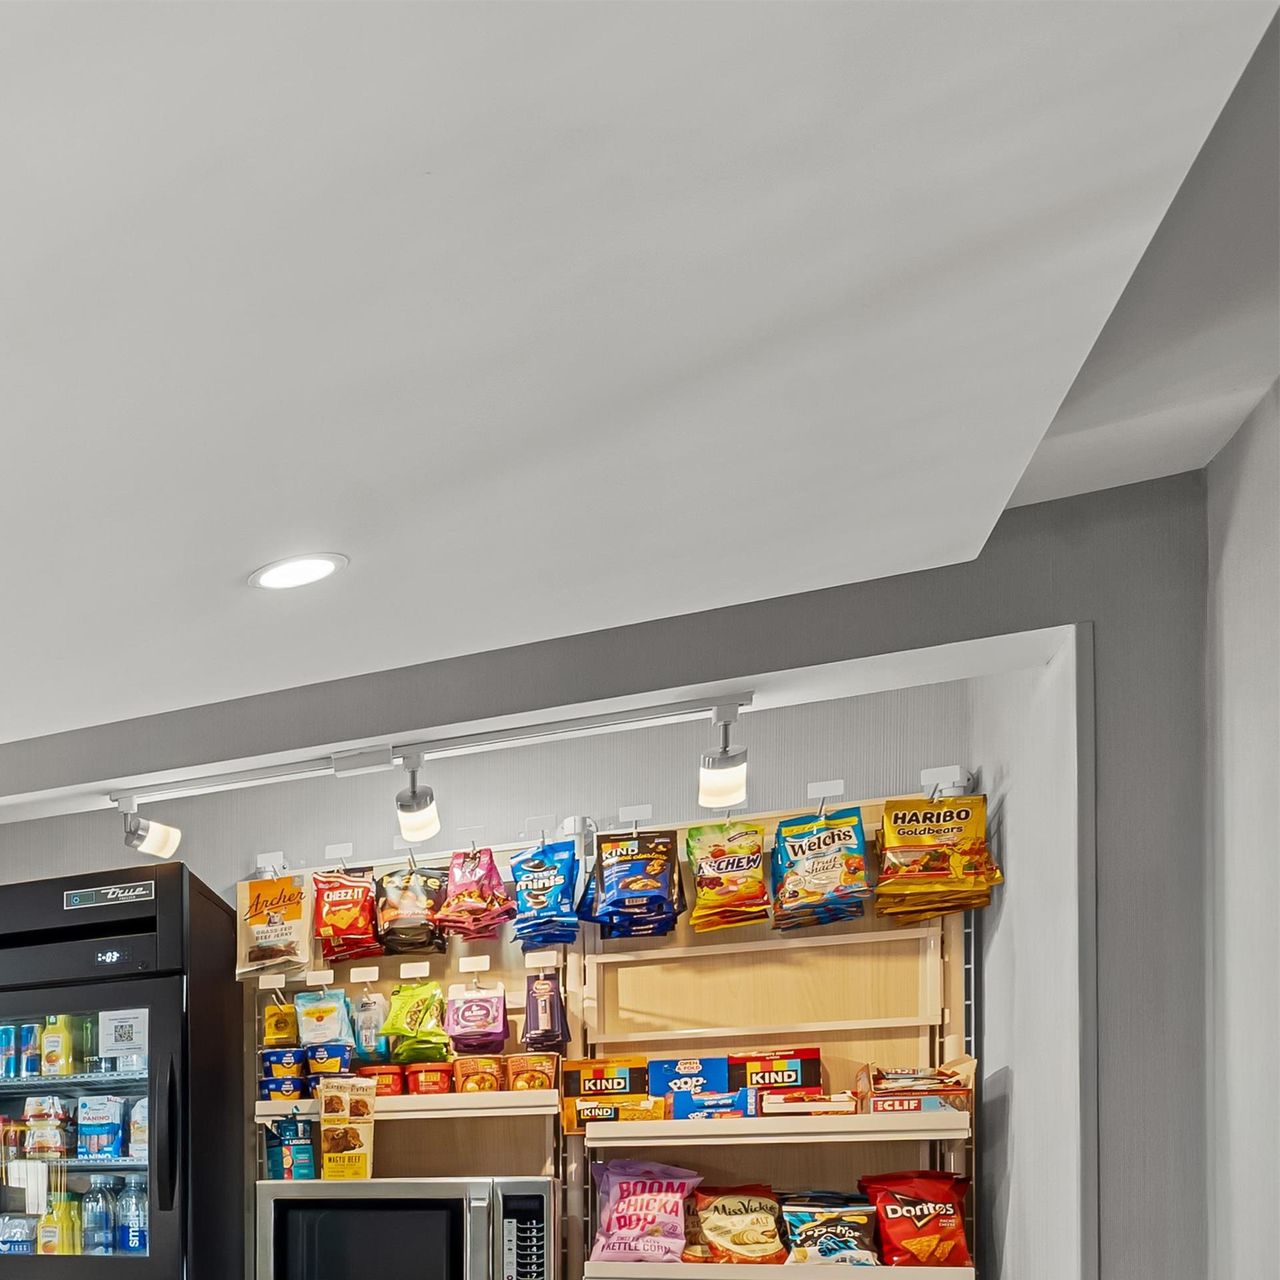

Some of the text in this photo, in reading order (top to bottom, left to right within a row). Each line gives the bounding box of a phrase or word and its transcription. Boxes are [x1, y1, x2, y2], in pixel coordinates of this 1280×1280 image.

[893, 808, 972, 825] HARIBO
[896, 825, 964, 836] Goldbears
[789, 829, 853, 857] Welch's
[602, 847, 639, 861] KIND
[516, 875, 565, 891] minis
[323, 888, 364, 901] CHEEZ-IT
[244, 888, 306, 917] Archer
[273, 931, 293, 939] JERKY
[752, 1071, 797, 1084] KIND
[584, 1078, 625, 1091] KIND
[883, 1100, 919, 1110] CLIF
[583, 1108, 611, 1116] KIND
[347, 1155, 361, 1163] BEEF
[618, 1180, 687, 1199] BOOM
[615, 1198, 680, 1217] CHICKA
[712, 1204, 742, 1217] Miss
[886, 1202, 955, 1219] Doritos
[750, 1216, 770, 1227] SALT
[605, 1241, 671, 1254] KETTLE CORN
